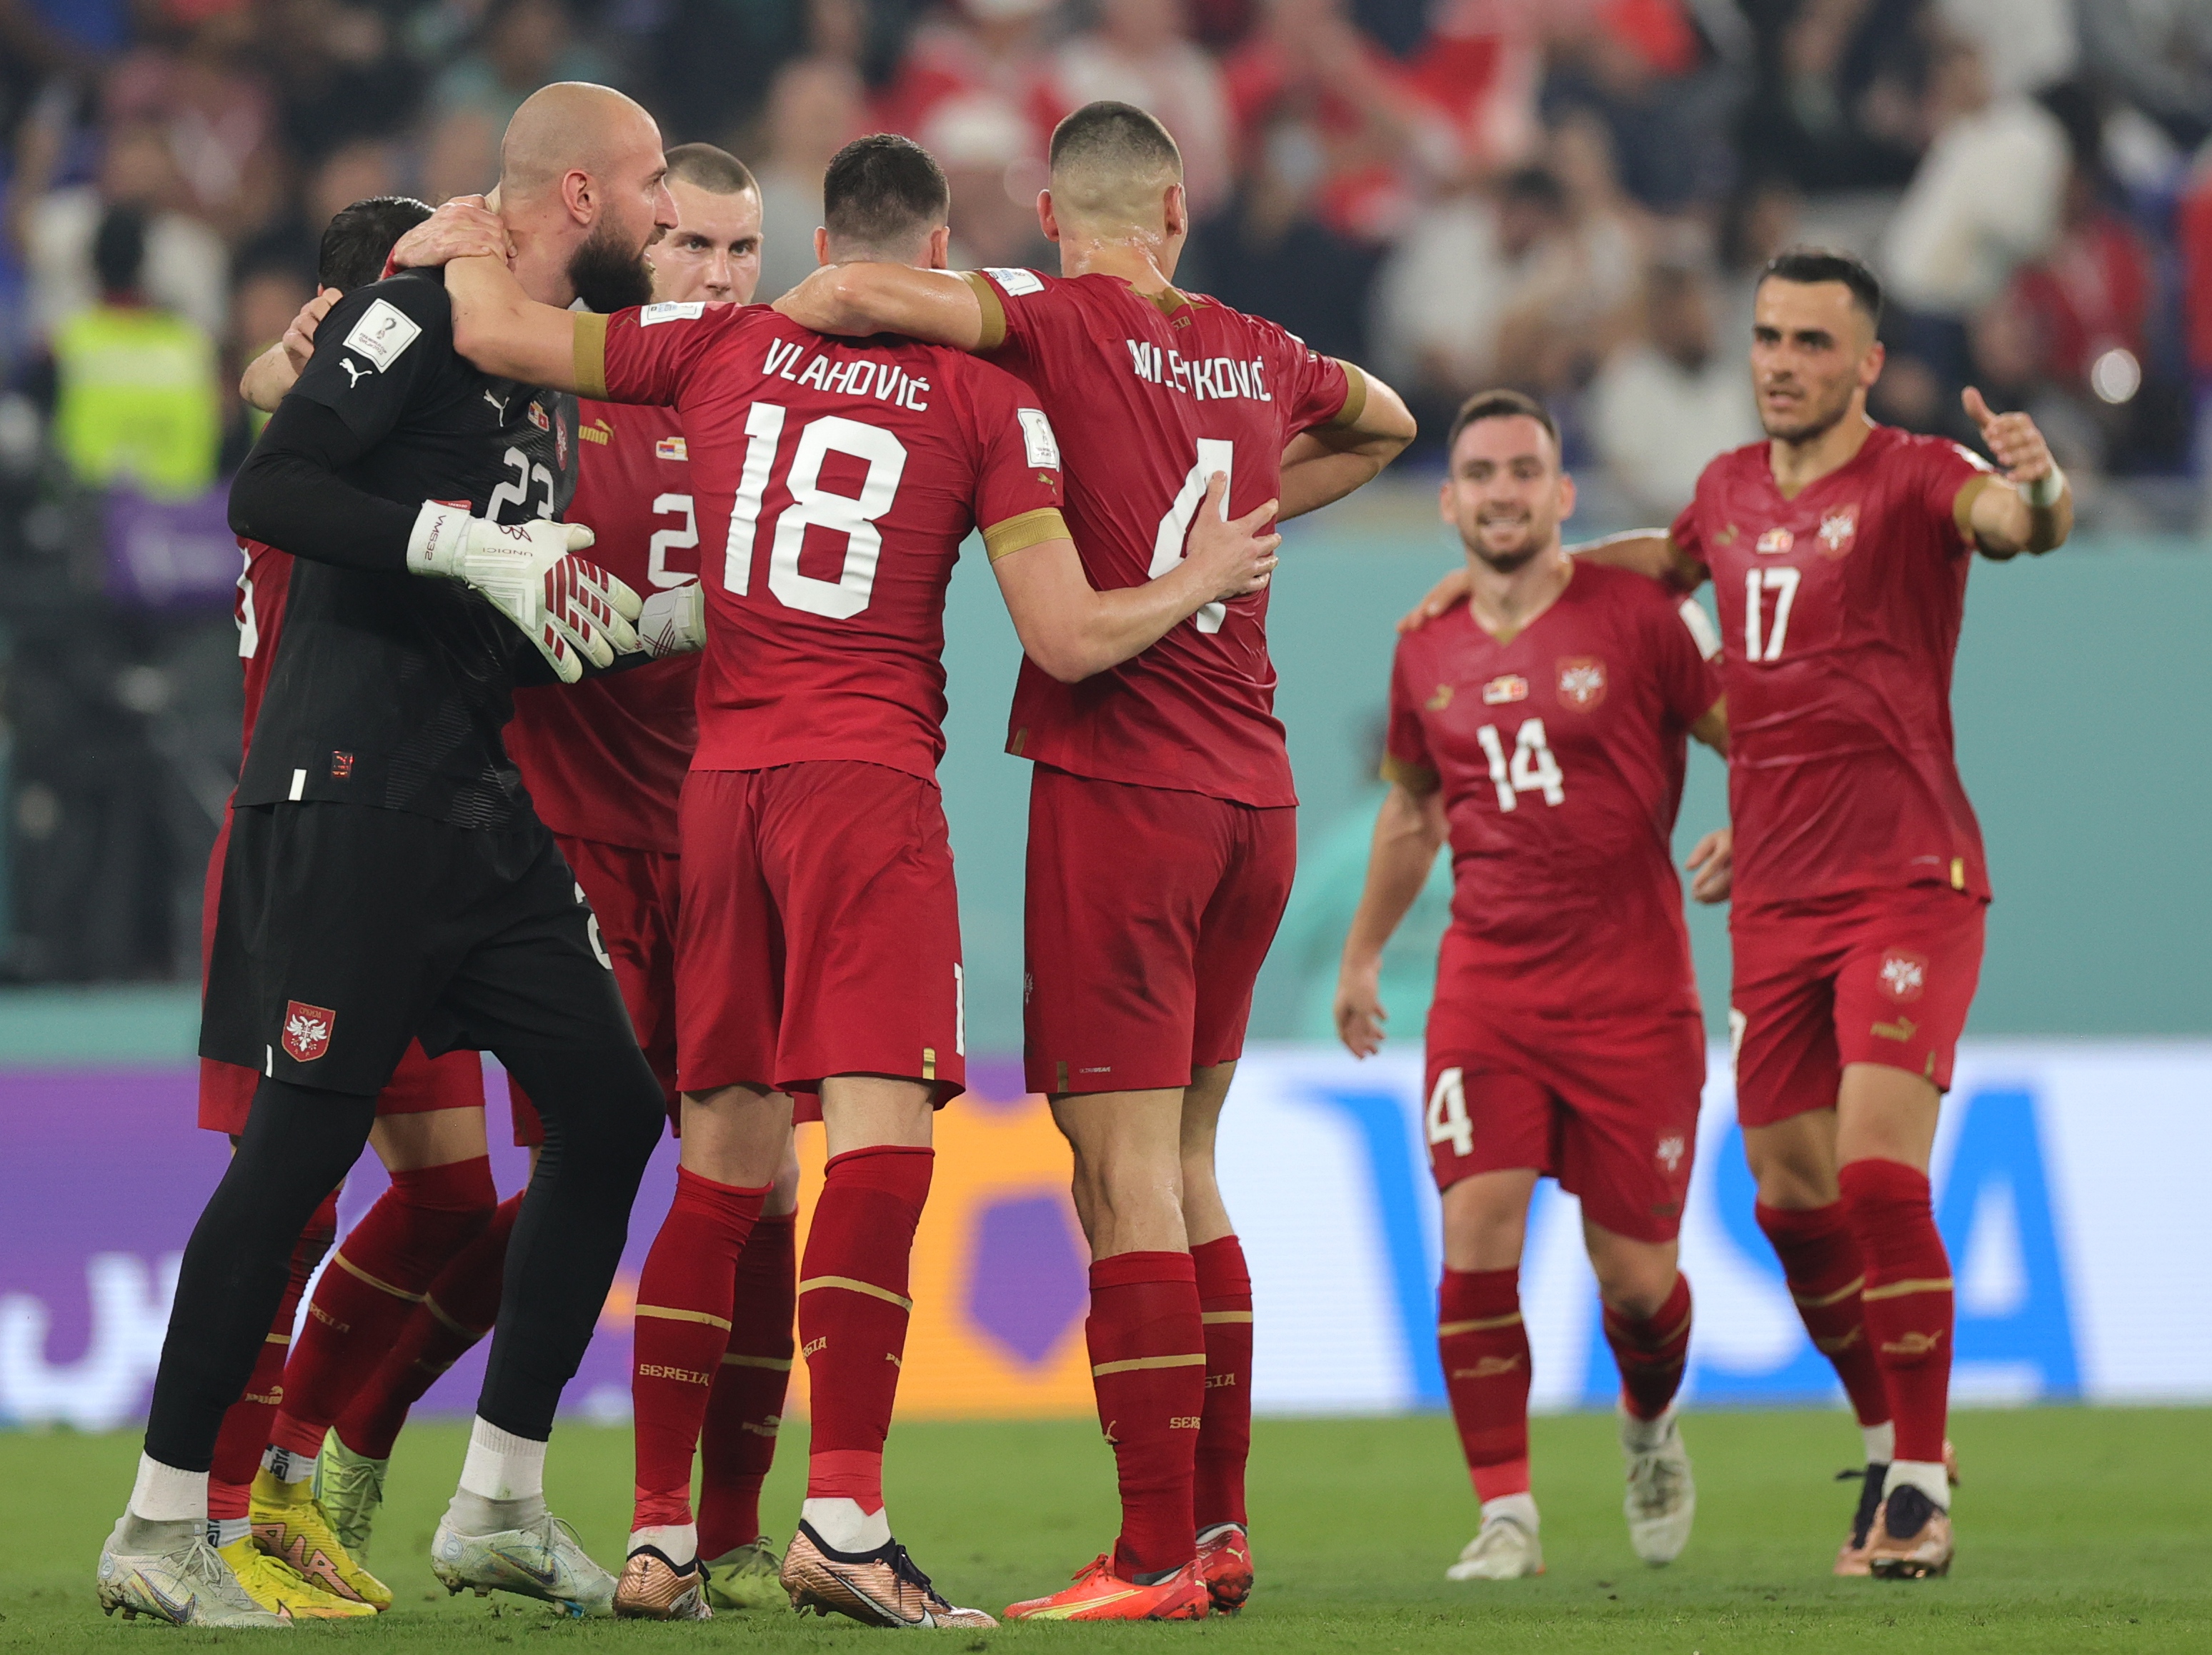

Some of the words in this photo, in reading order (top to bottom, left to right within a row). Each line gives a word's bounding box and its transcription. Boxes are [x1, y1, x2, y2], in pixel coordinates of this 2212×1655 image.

[762, 337, 930, 412] VLAHOVIĆ
[484, 446, 555, 522] 23
[723, 401, 909, 620] 18
[482, 547, 533, 557] UNDICI
[647, 492, 699, 588] 2
[1147, 437, 1234, 634] 4
[1745, 566, 1802, 662] 17
[1475, 717, 1566, 813] 14
[1286, 1085, 2085, 1405] VSA
